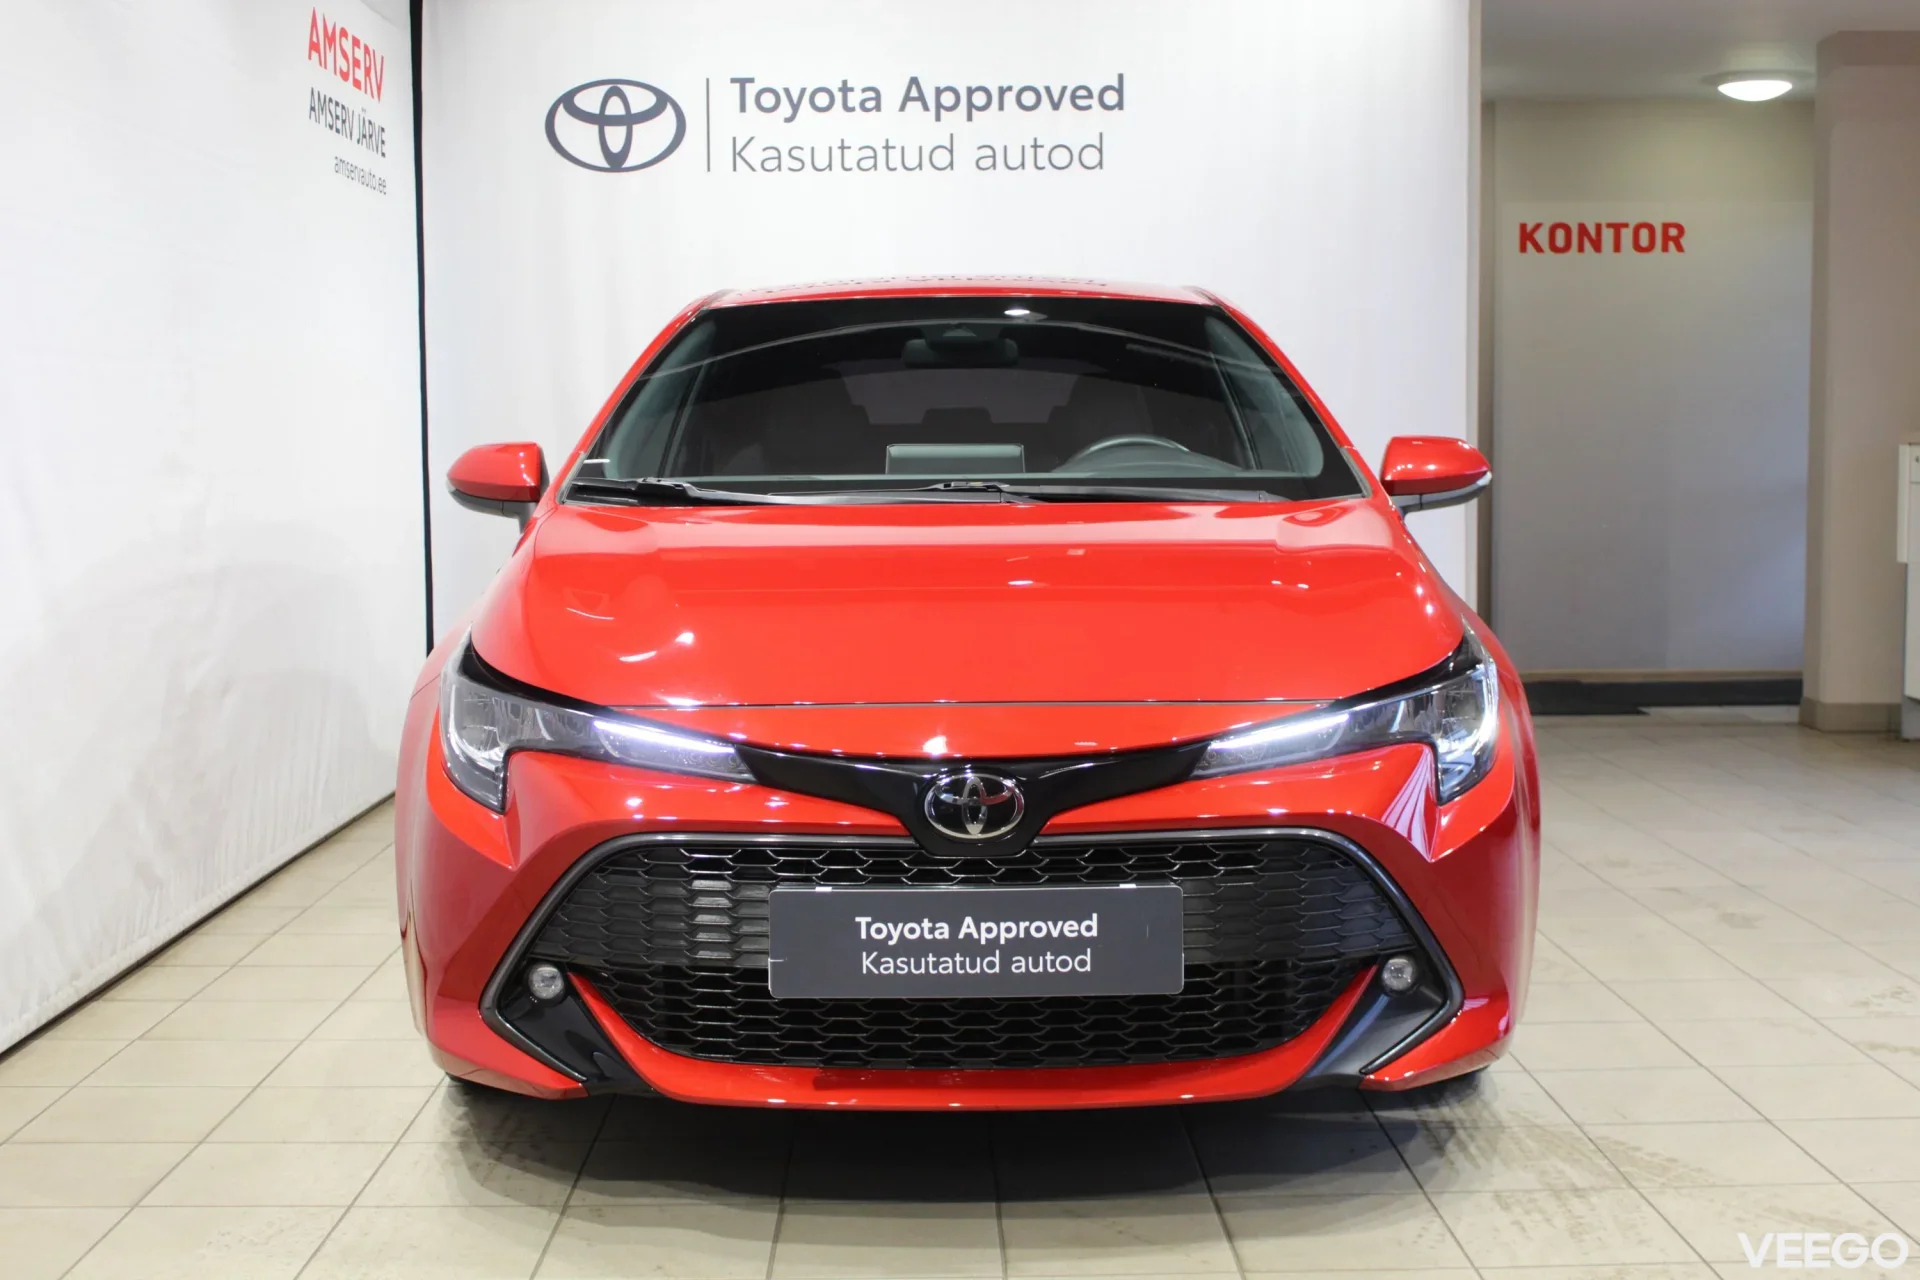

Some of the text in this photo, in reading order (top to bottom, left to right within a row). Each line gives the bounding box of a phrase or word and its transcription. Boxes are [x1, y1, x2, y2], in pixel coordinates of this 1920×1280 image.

[308, 7, 384, 103] AMSERV
[730, 73, 1125, 124] Toyota Approved
[309, 87, 386, 158] AMSERV JÄRVE
[732, 132, 1104, 172] Kasutatud autod
[334, 156, 387, 196] amservauto.ee
[1519, 222, 1686, 254] KONTOR
[855, 913, 1098, 945] Toyota Approved
[862, 948, 1091, 975] Kasutatud autod
